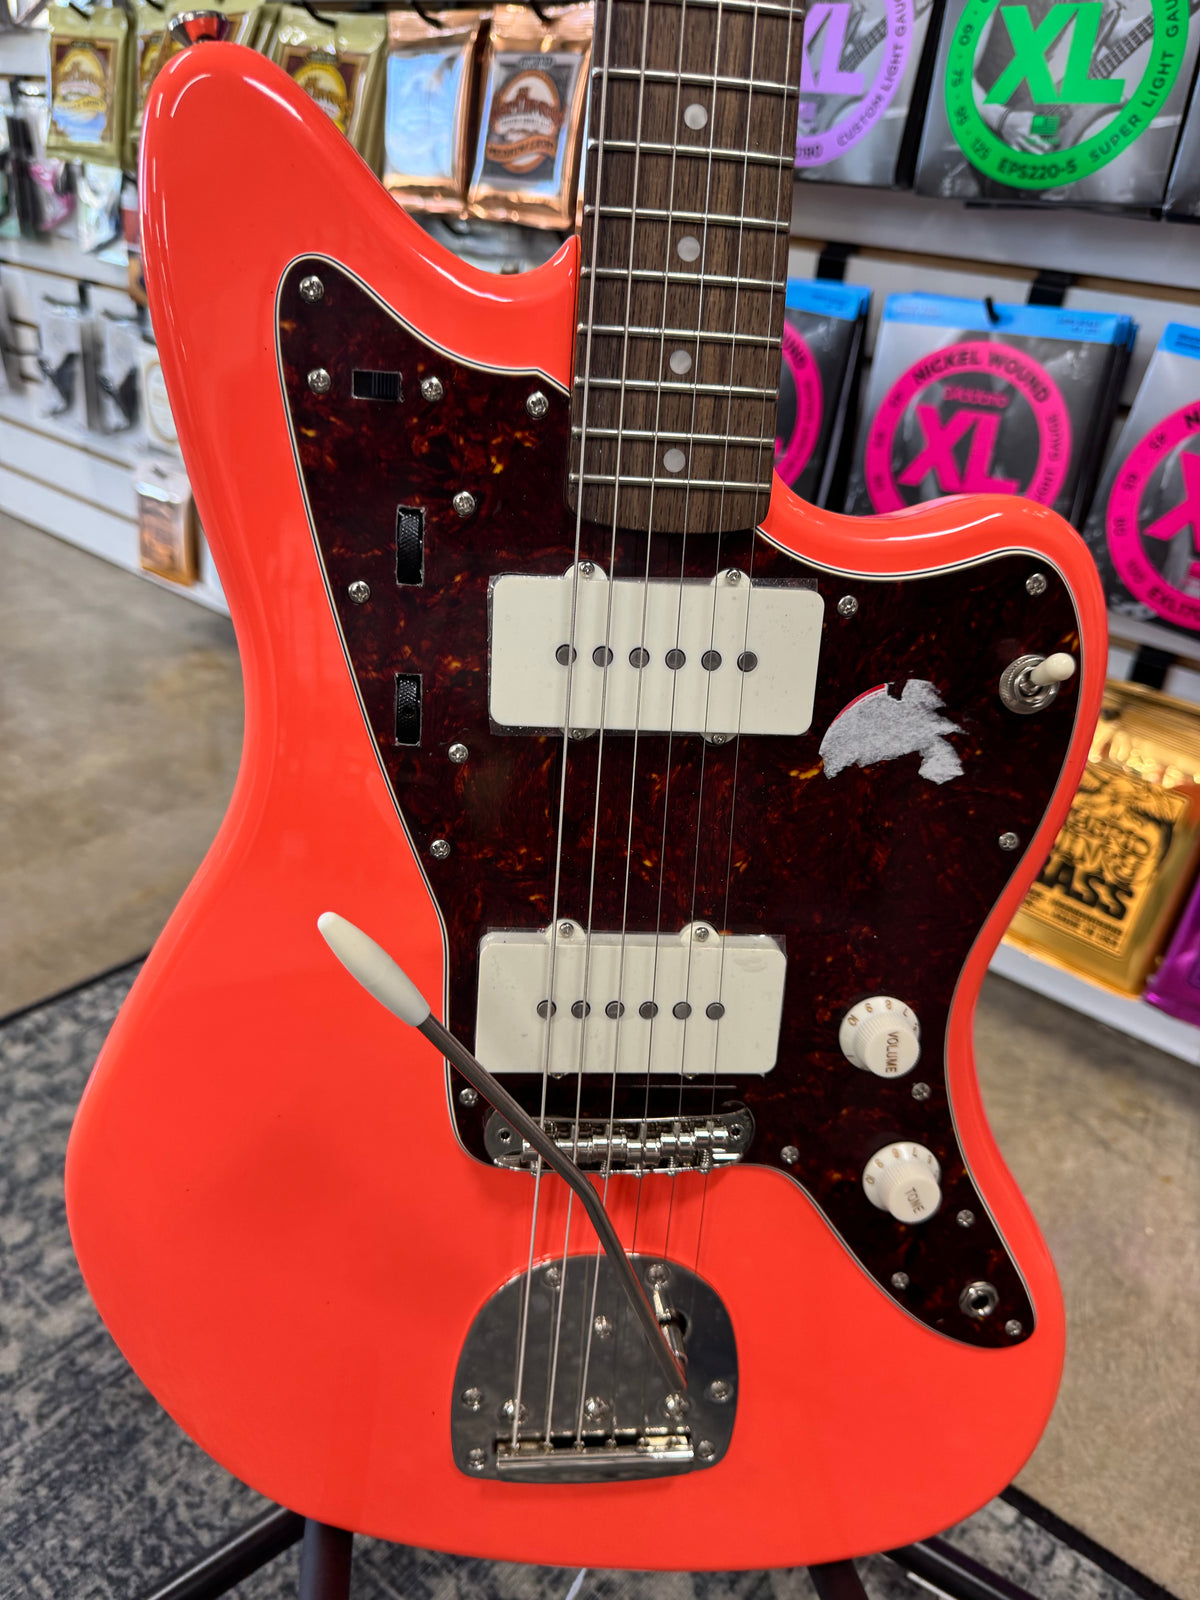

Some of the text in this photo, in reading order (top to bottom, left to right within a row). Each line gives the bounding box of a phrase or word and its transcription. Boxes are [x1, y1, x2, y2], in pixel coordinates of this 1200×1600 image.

[983, 3, 1126, 105] XL
[836, 94, 883, 147] CUSTOM
[881, 44, 904, 92] LIGHT
[1088, 113, 1142, 163] SUPER
[1141, 50, 1175, 109] LIGHT
[997, 157, 1078, 181] EPS220-5
[912, 351, 1049, 404] NICKEL WOUND
[897, 402, 1021, 496] XL
[885, 1030, 899, 1073] VOLUME
[904, 1186, 925, 1214] TONE
